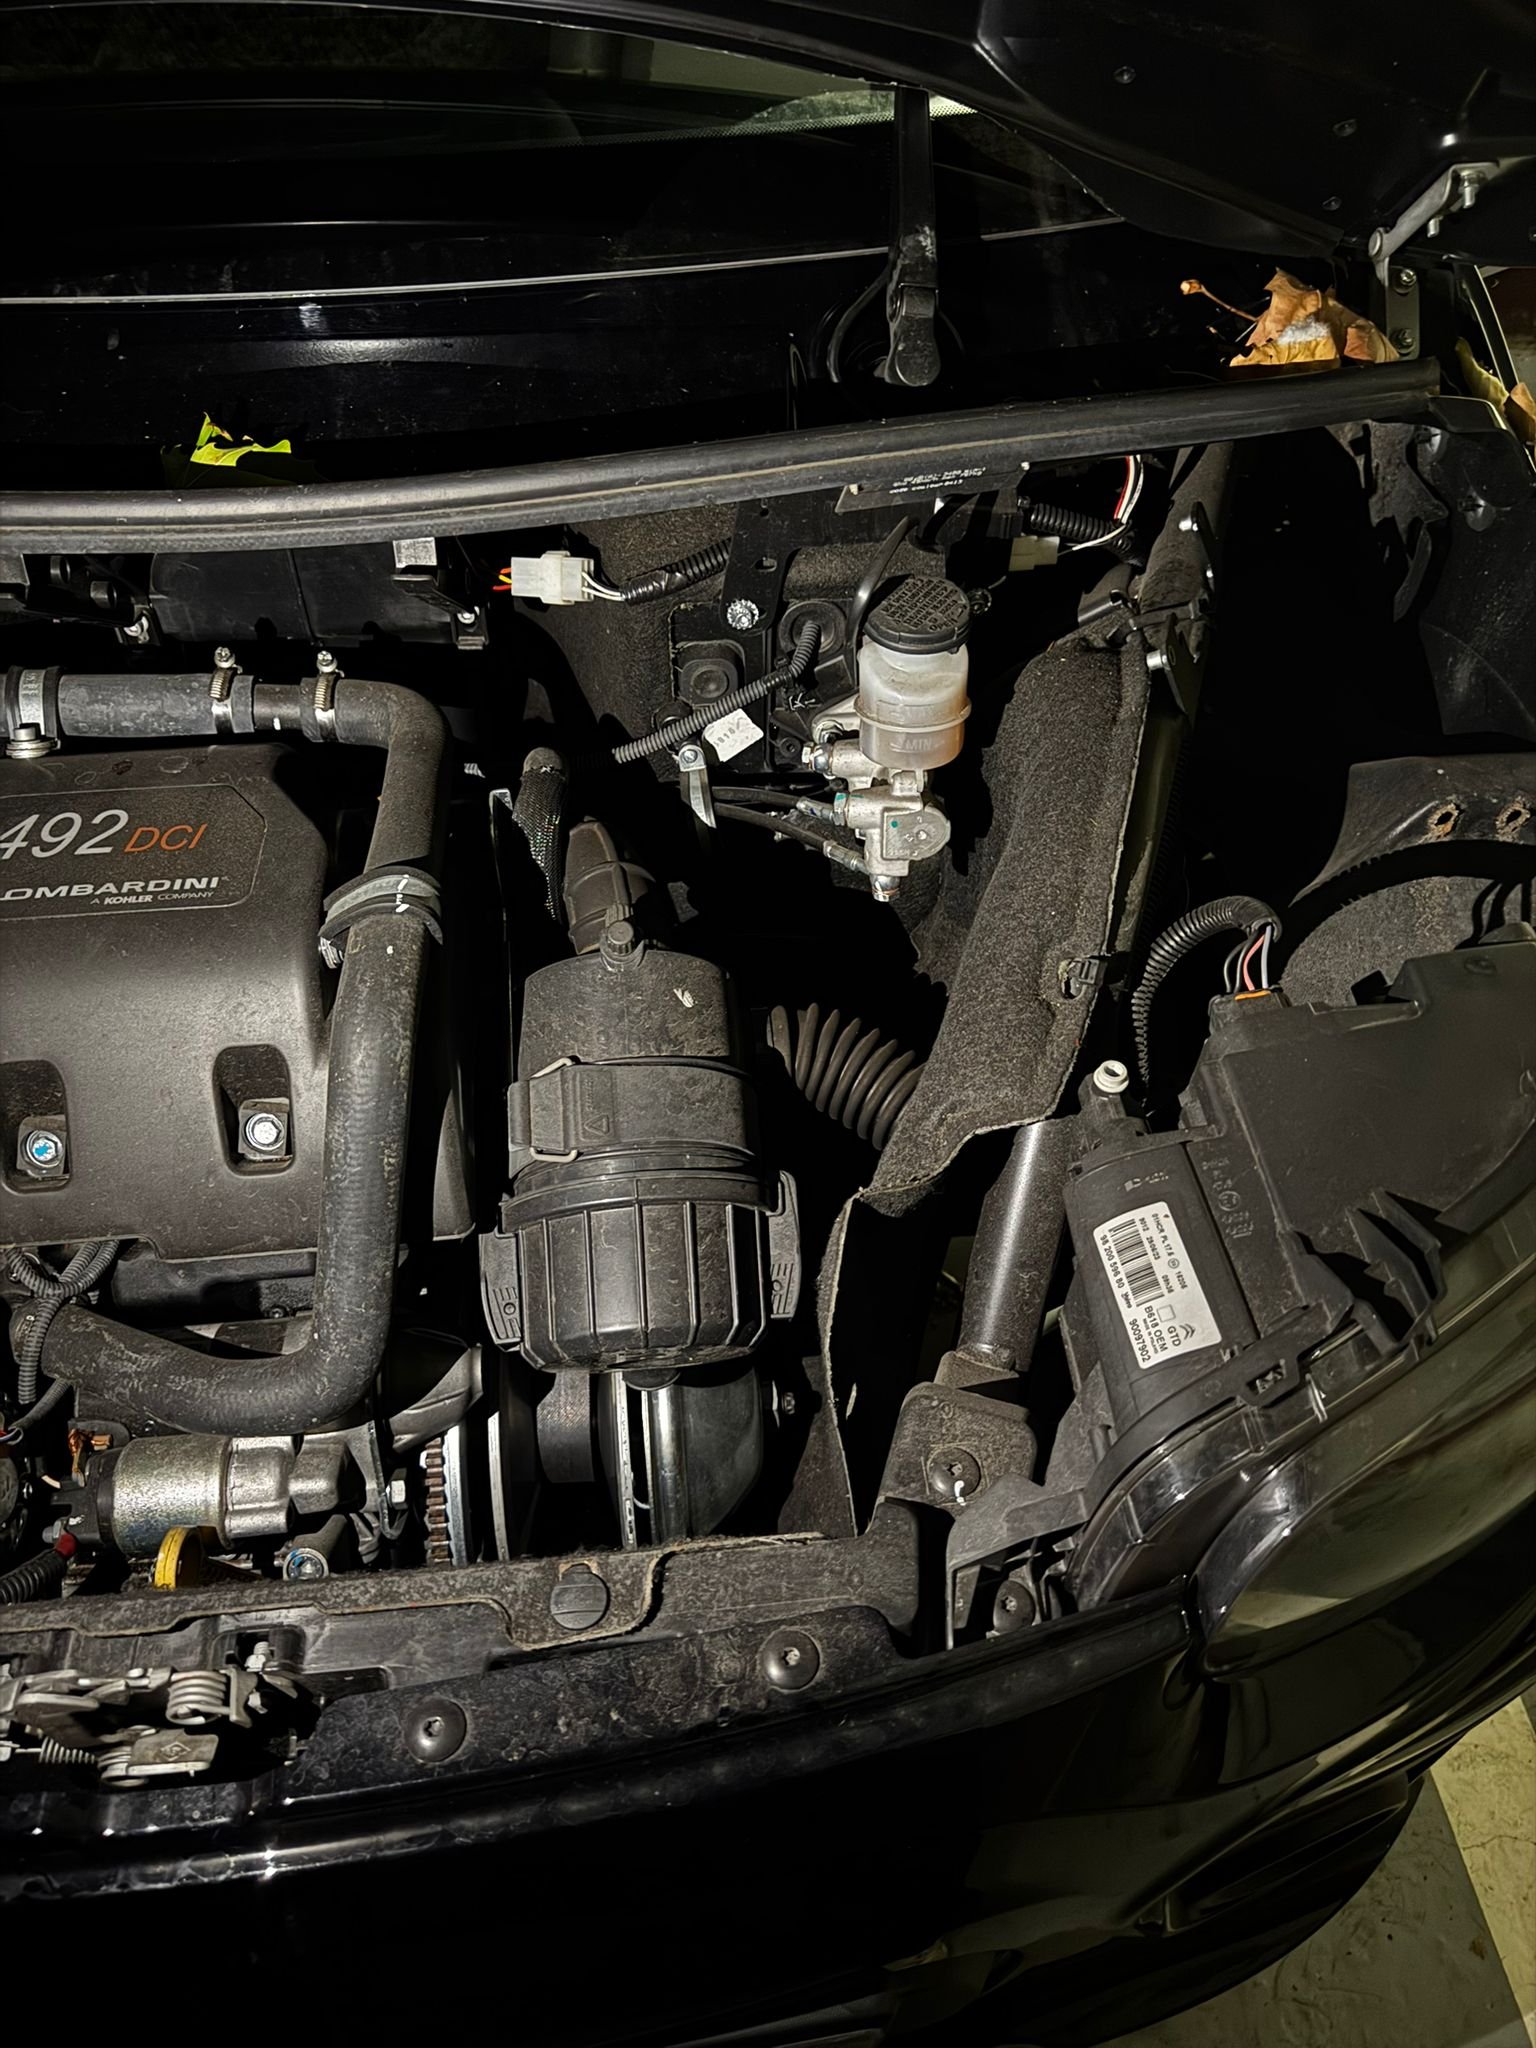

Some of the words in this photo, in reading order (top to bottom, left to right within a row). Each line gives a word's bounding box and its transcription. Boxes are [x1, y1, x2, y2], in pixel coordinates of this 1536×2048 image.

[0, 809, 129, 860] 492
[124, 823, 208, 853] DCI
[104, 895, 153, 905] KOHLER
[157, 891, 214, 901] COMPANY
[1104, 1246, 1115, 1261] 200
[1115, 1277, 1125, 1289] 80
[1129, 1318, 1151, 1363] 90097902
[1144, 1305, 1159, 1328] B618
[1153, 1329, 1168, 1352] OEM
[1167, 1325, 1182, 1347] GTD
